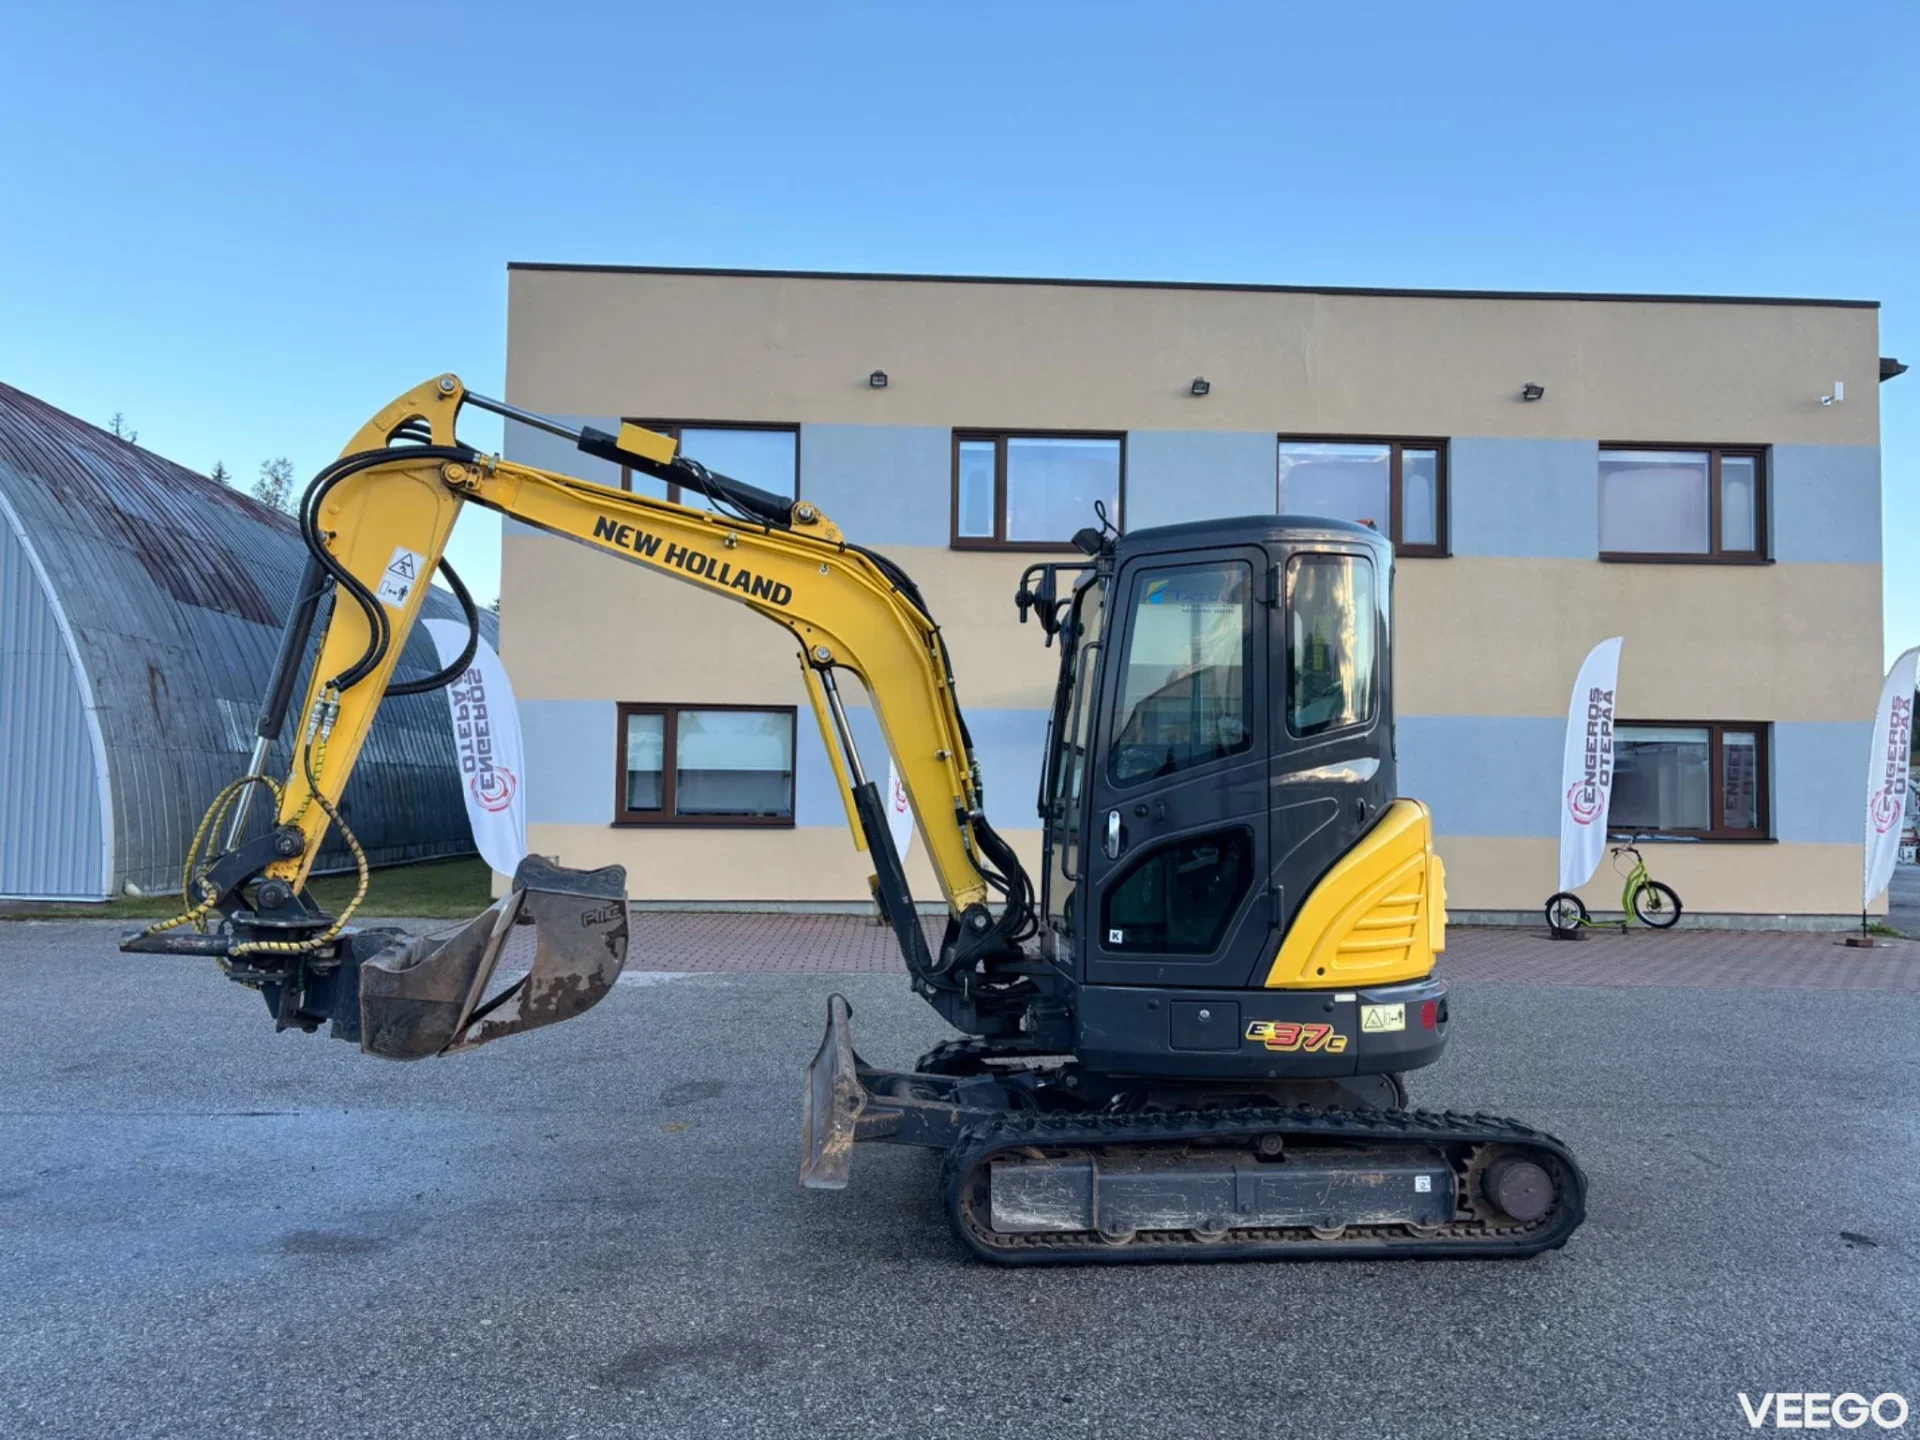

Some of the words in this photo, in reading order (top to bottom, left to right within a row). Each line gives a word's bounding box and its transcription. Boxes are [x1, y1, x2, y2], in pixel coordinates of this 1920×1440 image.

[593, 516, 662, 557] NEW
[664, 543, 793, 606] HOLLAND
[1584, 687, 1600, 804] ENGEROS
[1599, 690, 1613, 786] OTEPÄÄ
[1884, 695, 1901, 811] ENGEROS
